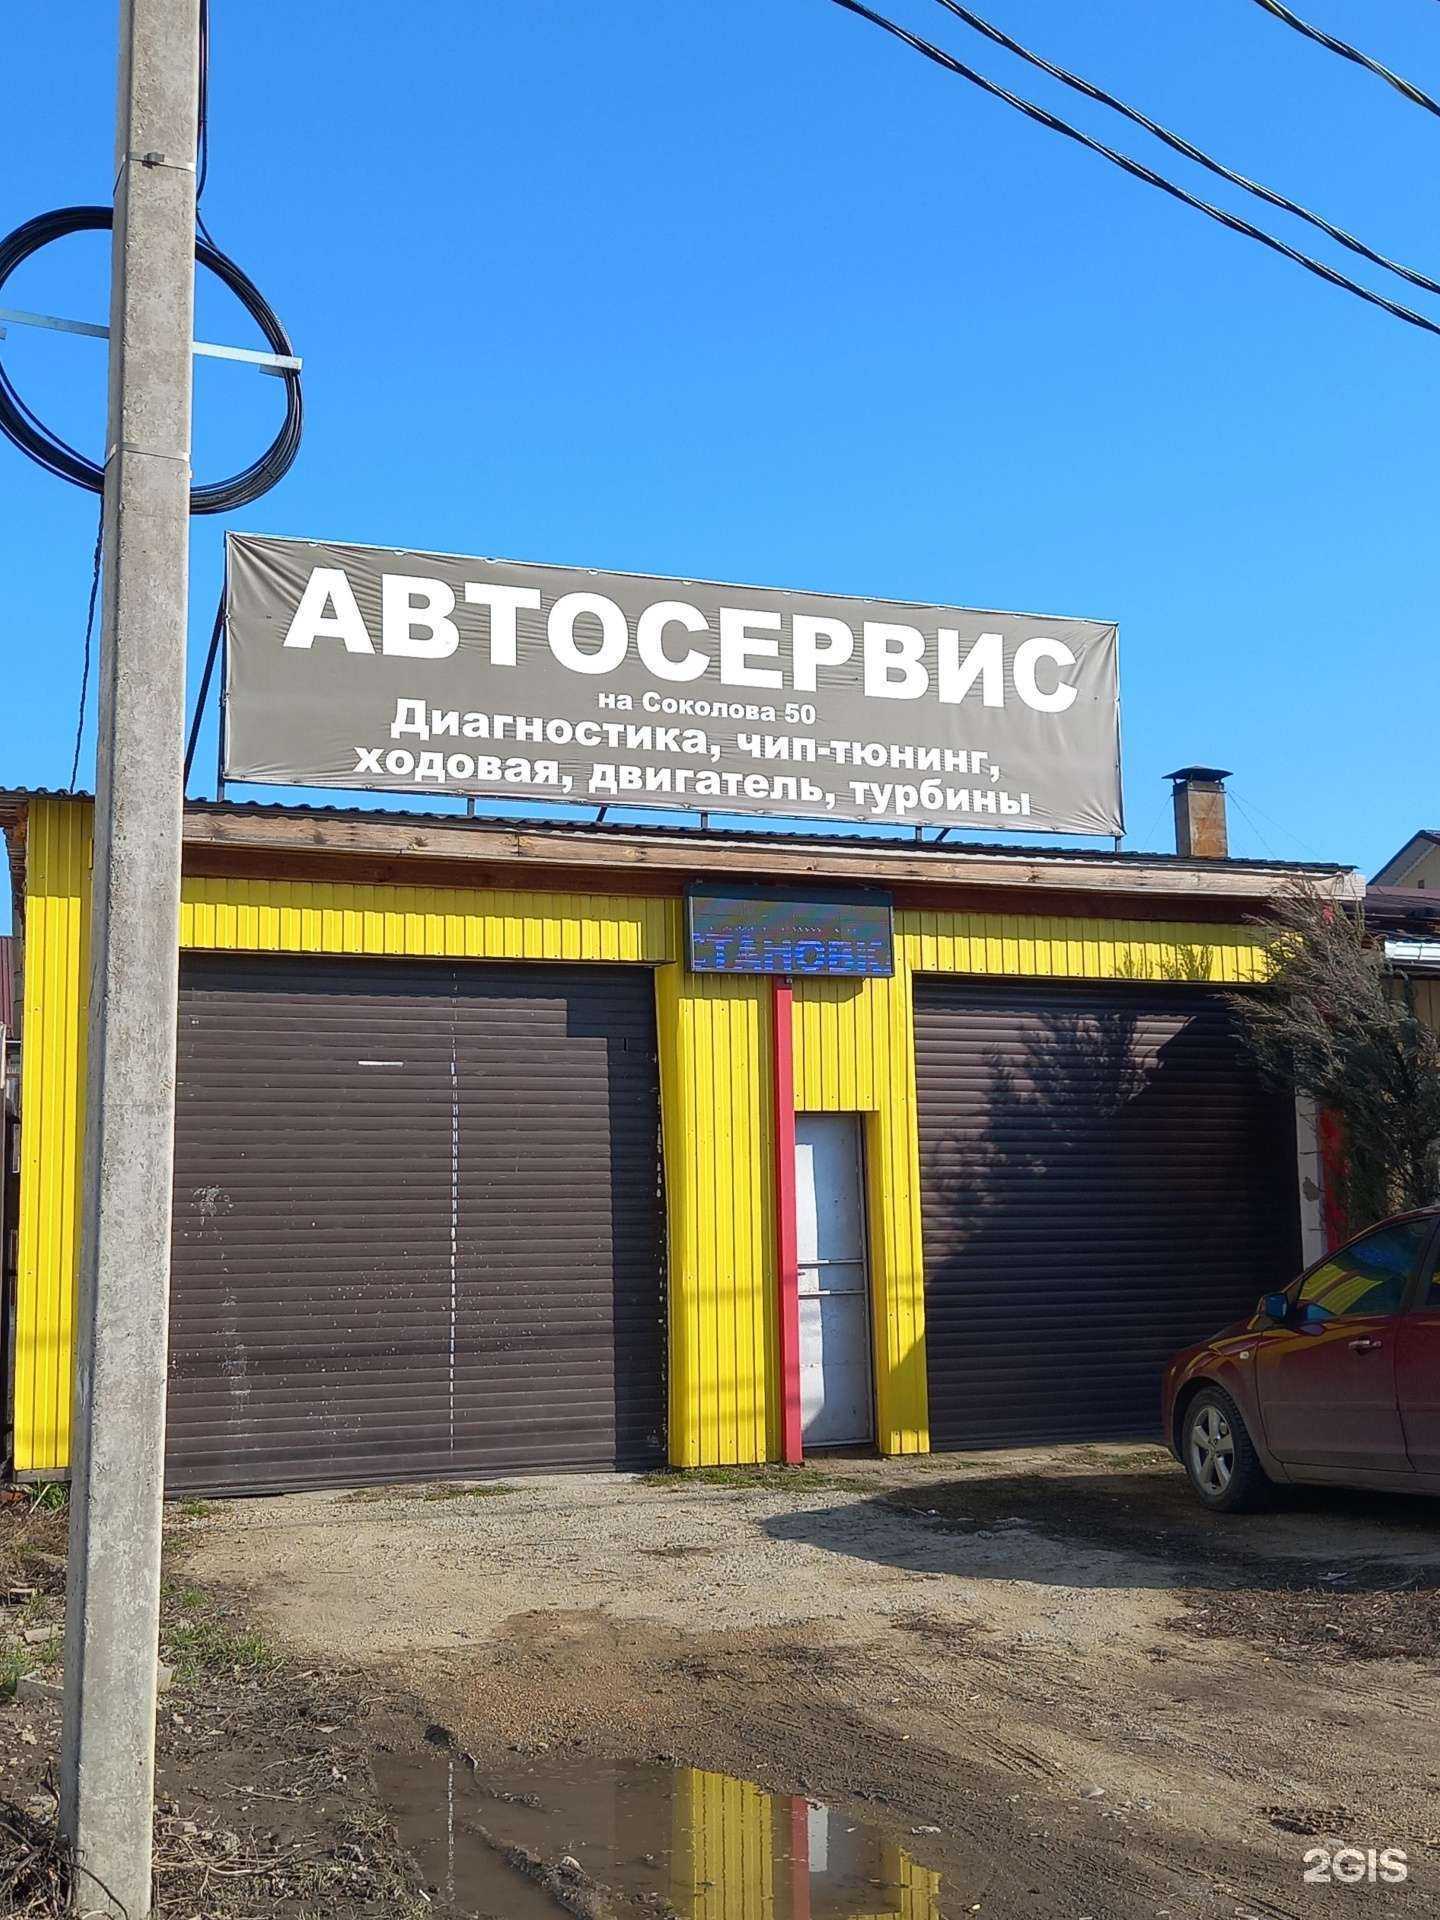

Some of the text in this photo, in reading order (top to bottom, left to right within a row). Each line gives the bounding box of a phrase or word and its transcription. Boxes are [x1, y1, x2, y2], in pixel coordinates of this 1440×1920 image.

[283, 566, 1078, 713] АВТОСЕРВИС
[390, 698, 1000, 782] Диагностика, чип-тюнинг,
[598, 691, 817, 725] на Соколова 50
[353, 746, 1031, 816] ходовая, двигатель, турбины
